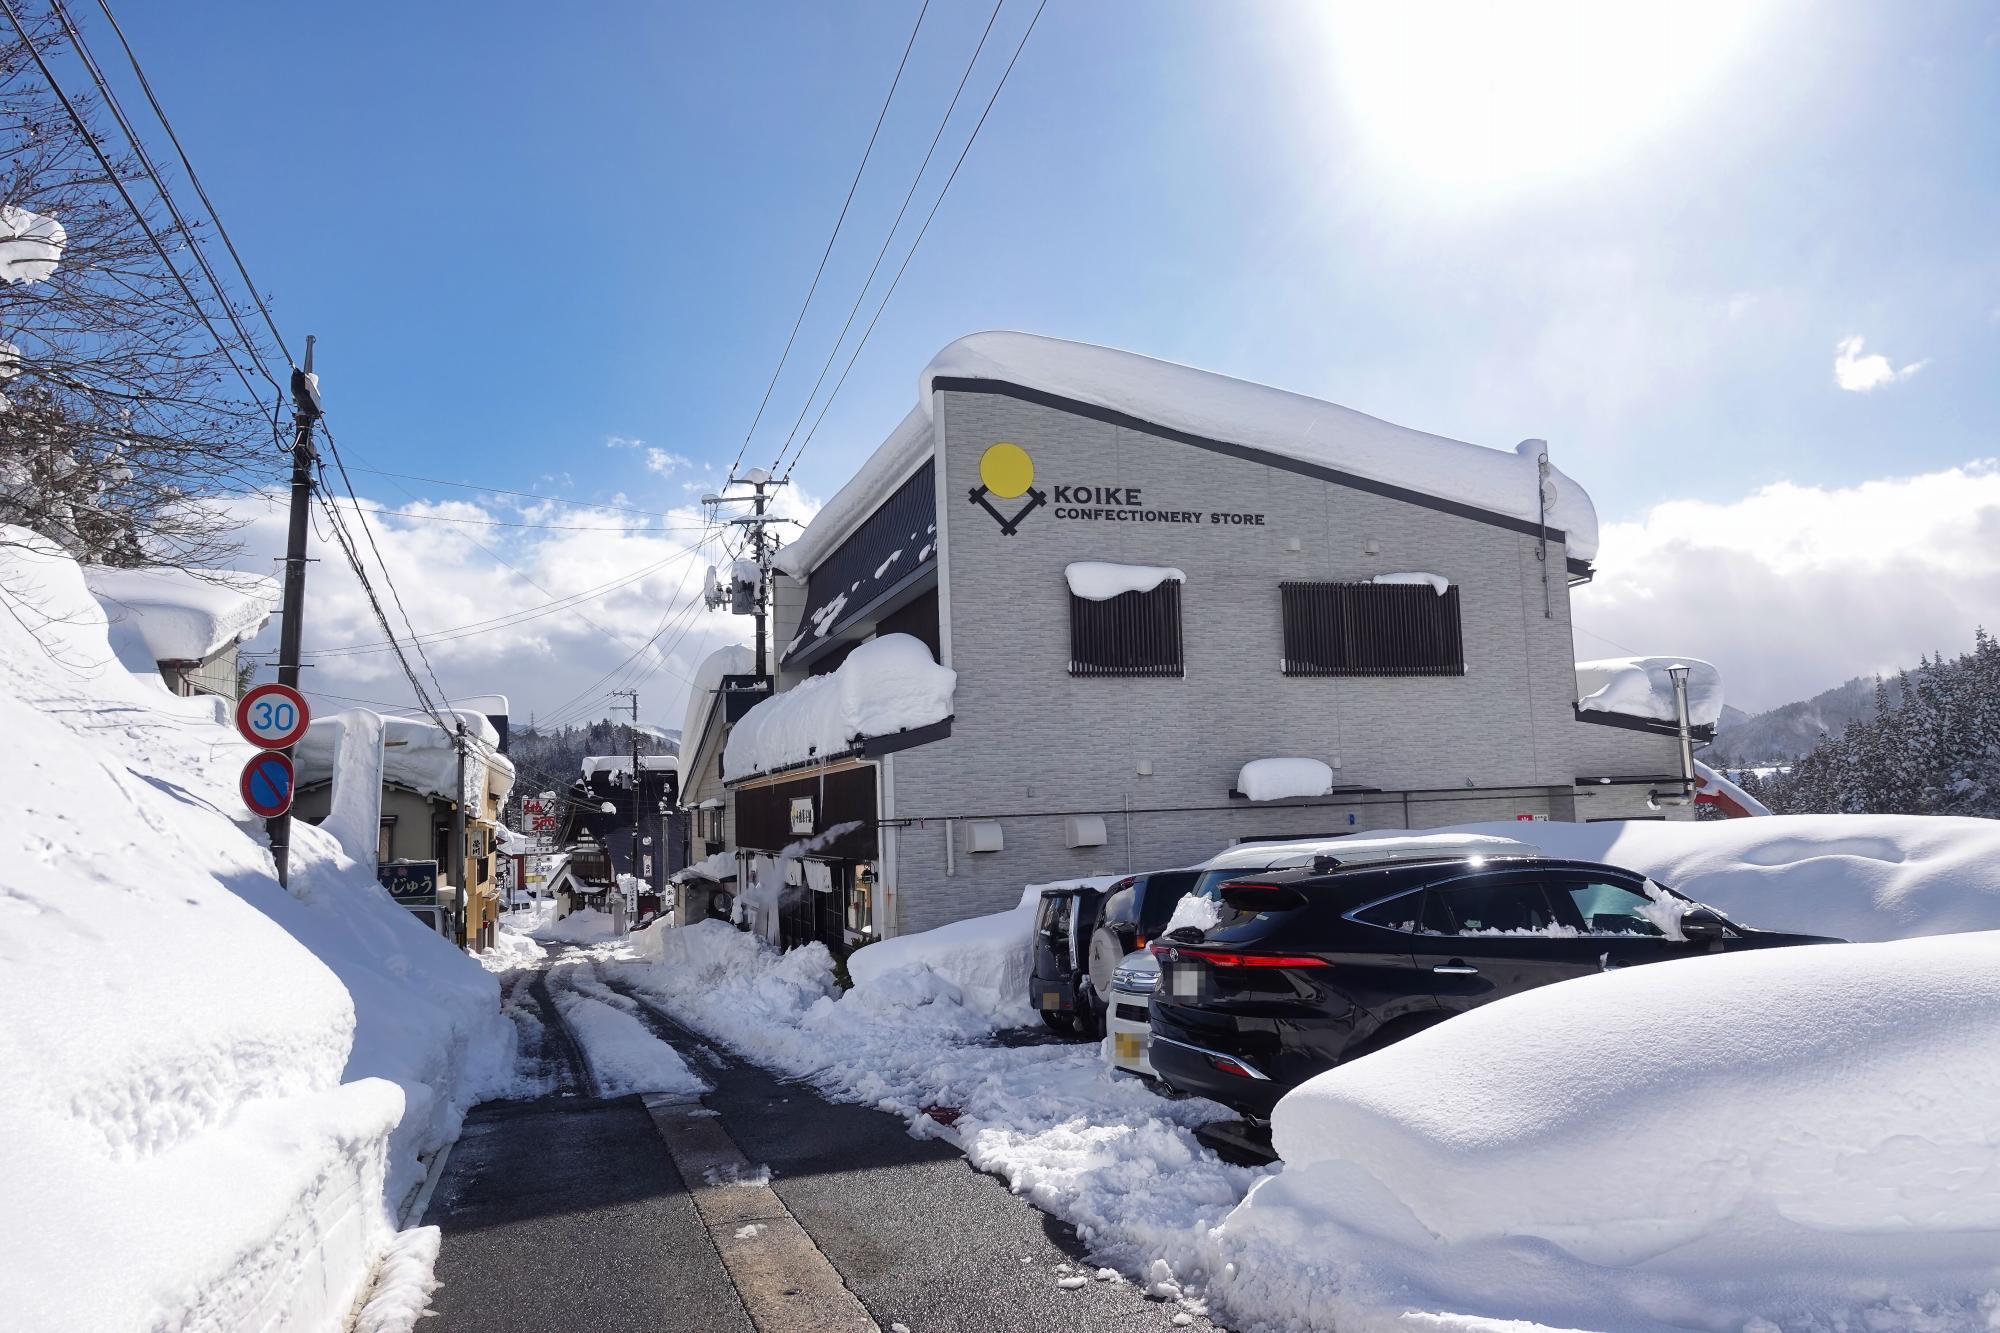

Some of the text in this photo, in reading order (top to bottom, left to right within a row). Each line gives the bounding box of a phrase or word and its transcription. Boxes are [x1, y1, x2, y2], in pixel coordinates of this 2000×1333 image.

[1054, 486, 1142, 506] KOIKE
[1054, 507, 1265, 525] CONFECTIONERY STORE
[253, 702, 294, 731] 30
